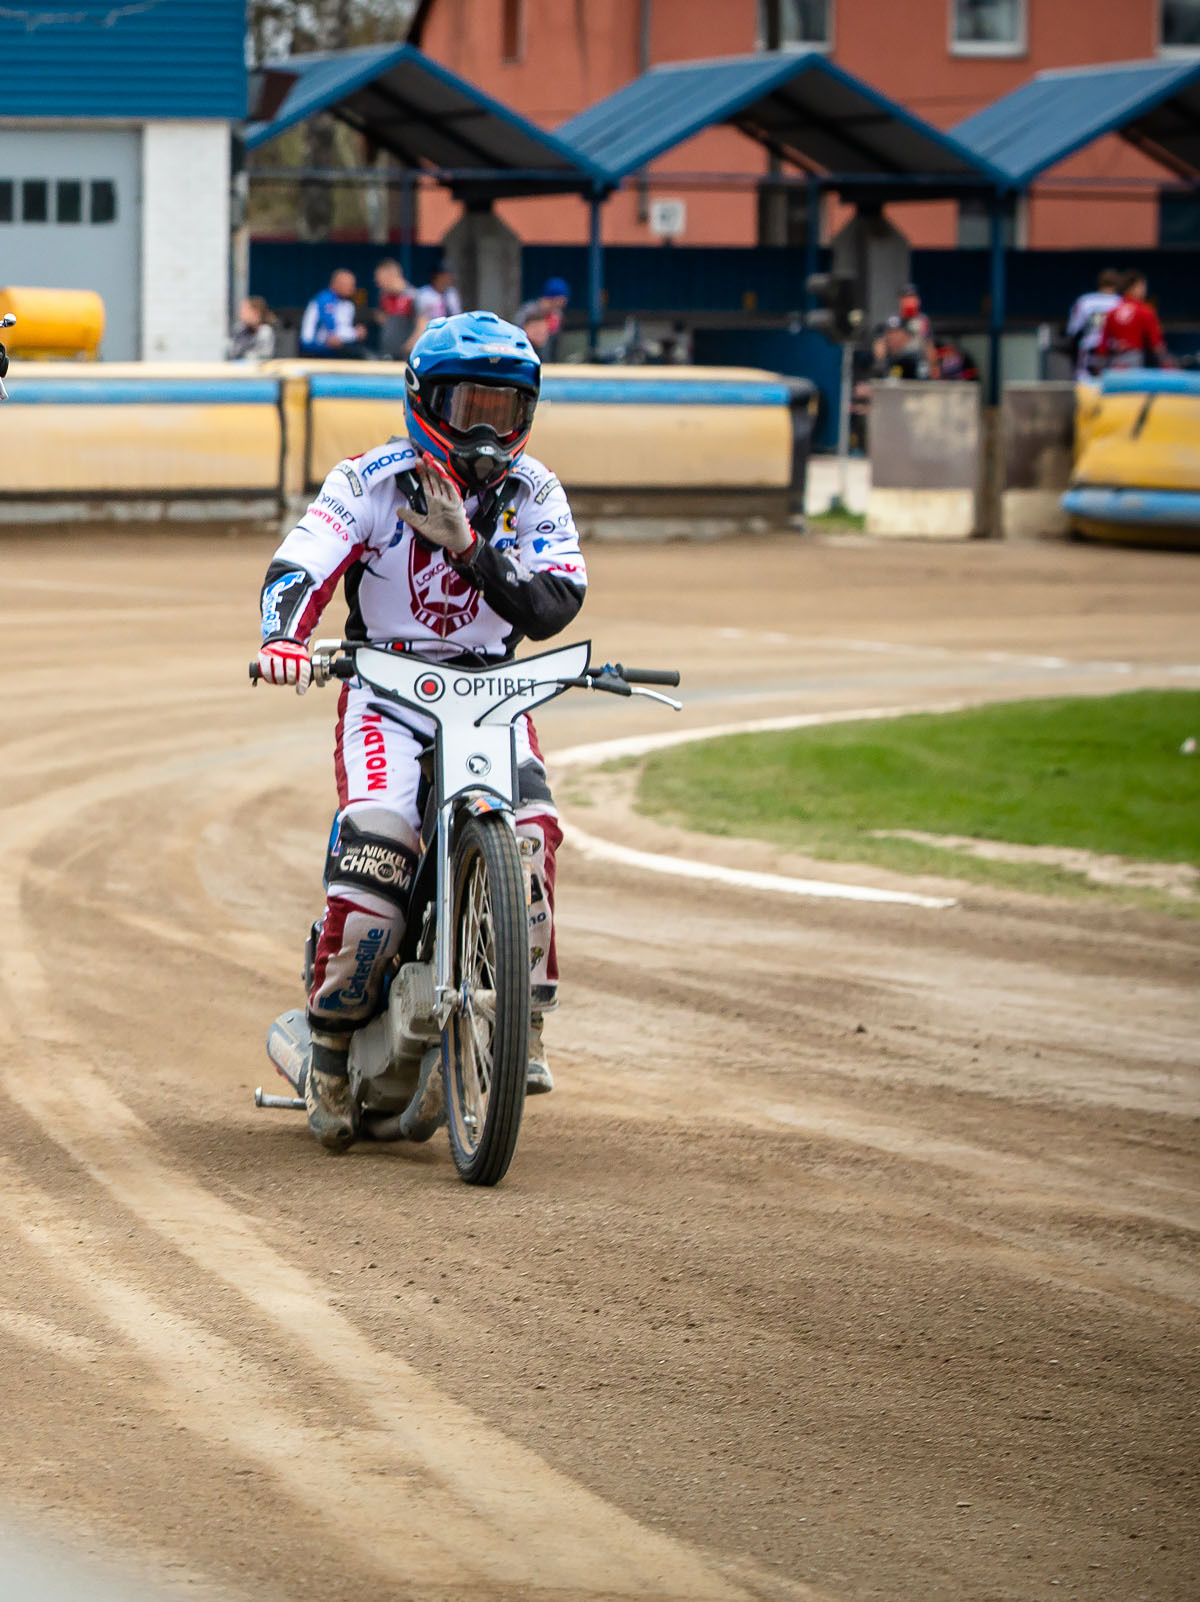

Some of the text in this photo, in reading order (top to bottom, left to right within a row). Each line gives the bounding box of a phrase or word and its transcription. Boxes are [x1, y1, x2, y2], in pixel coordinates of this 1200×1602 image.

[453, 677, 537, 697] OPTIBET
[362, 844, 407, 870] NIKKEL
[340, 855, 412, 890] CHROM
